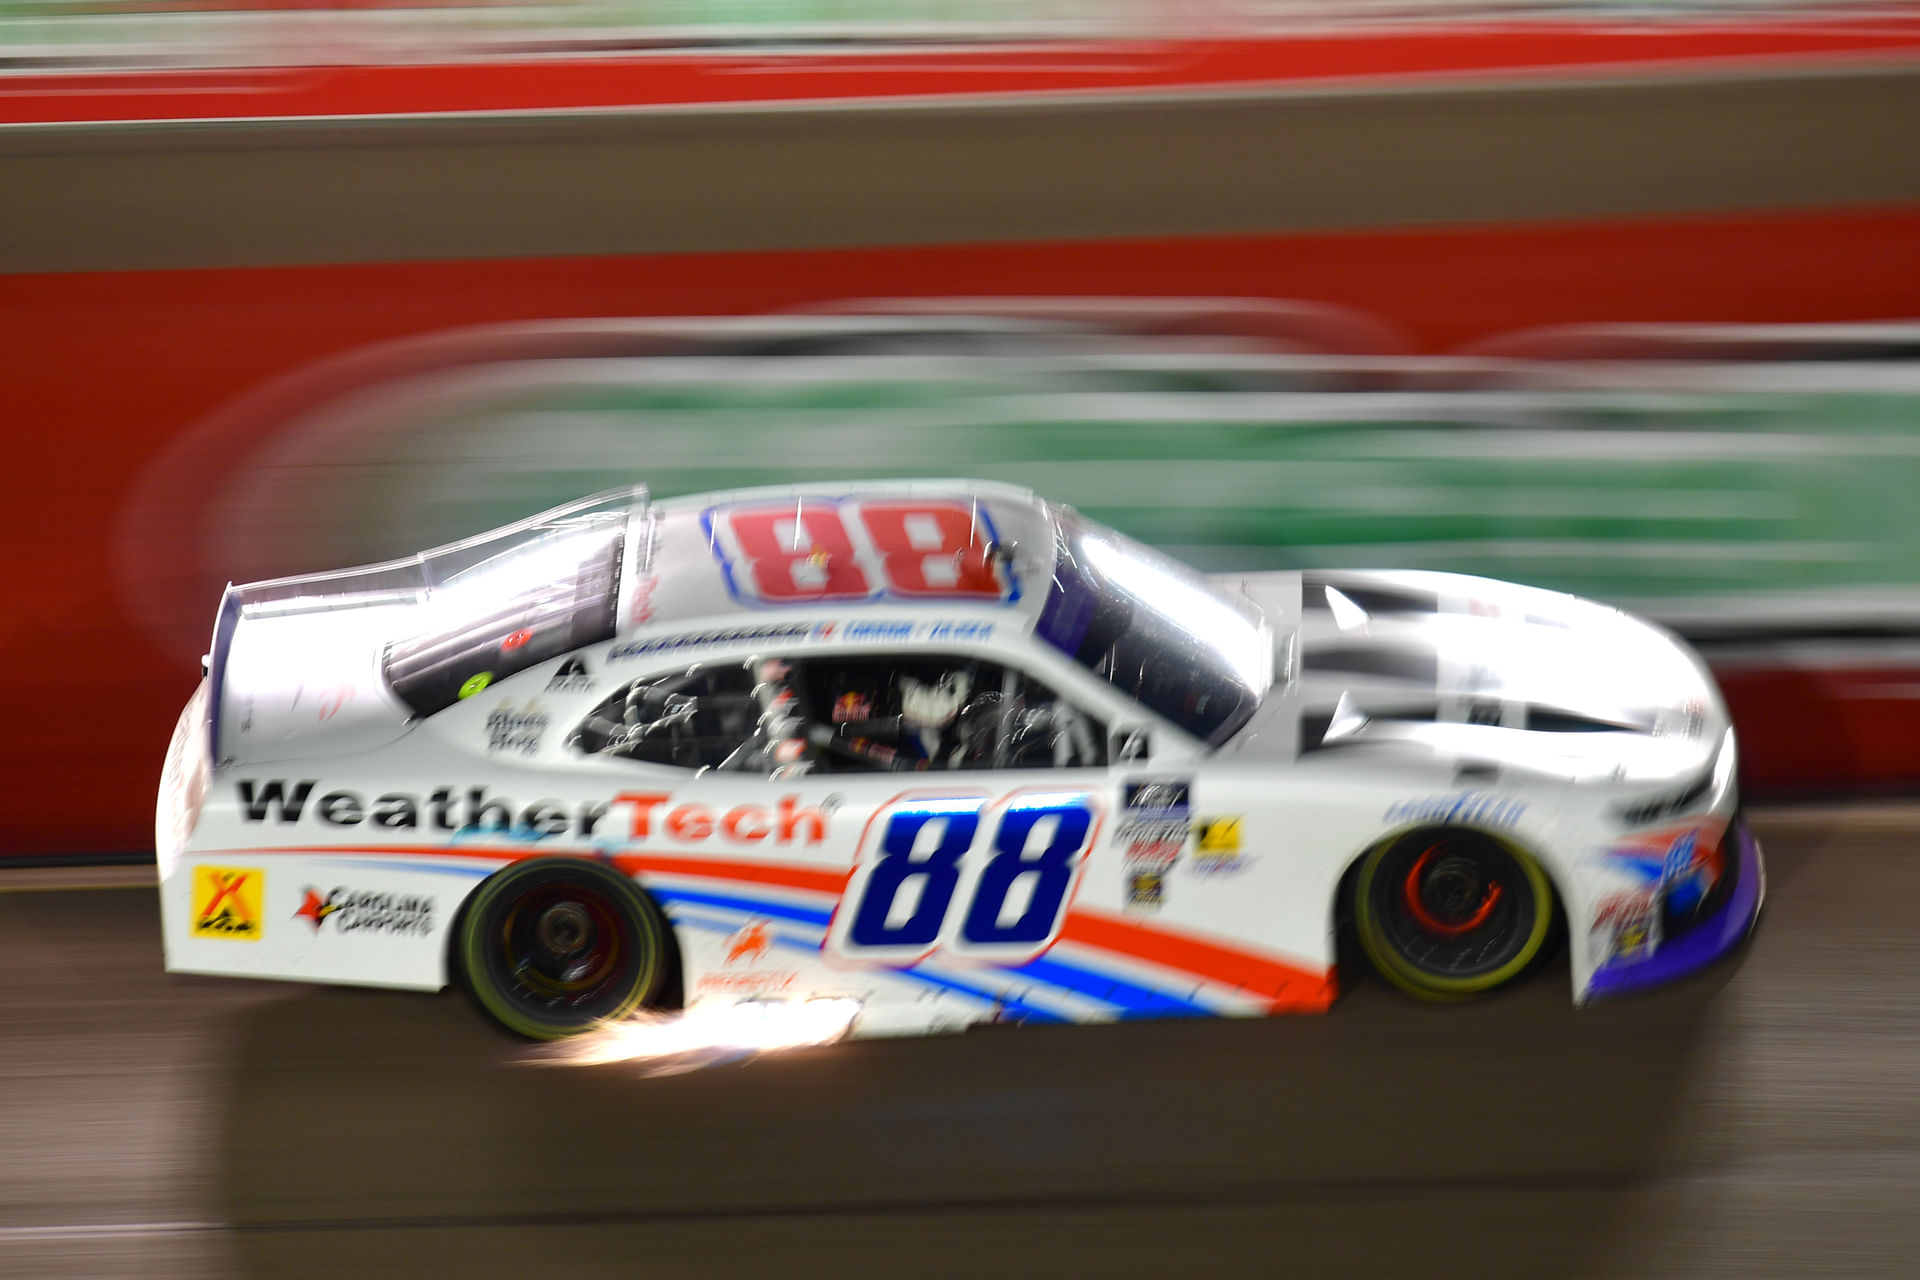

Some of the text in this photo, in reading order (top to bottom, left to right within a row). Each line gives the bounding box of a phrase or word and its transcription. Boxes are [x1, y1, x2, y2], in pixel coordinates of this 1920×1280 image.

[728, 504, 1003, 599] 88
[236, 779, 828, 843] WeatherTech
[850, 792, 1093, 946] 88
